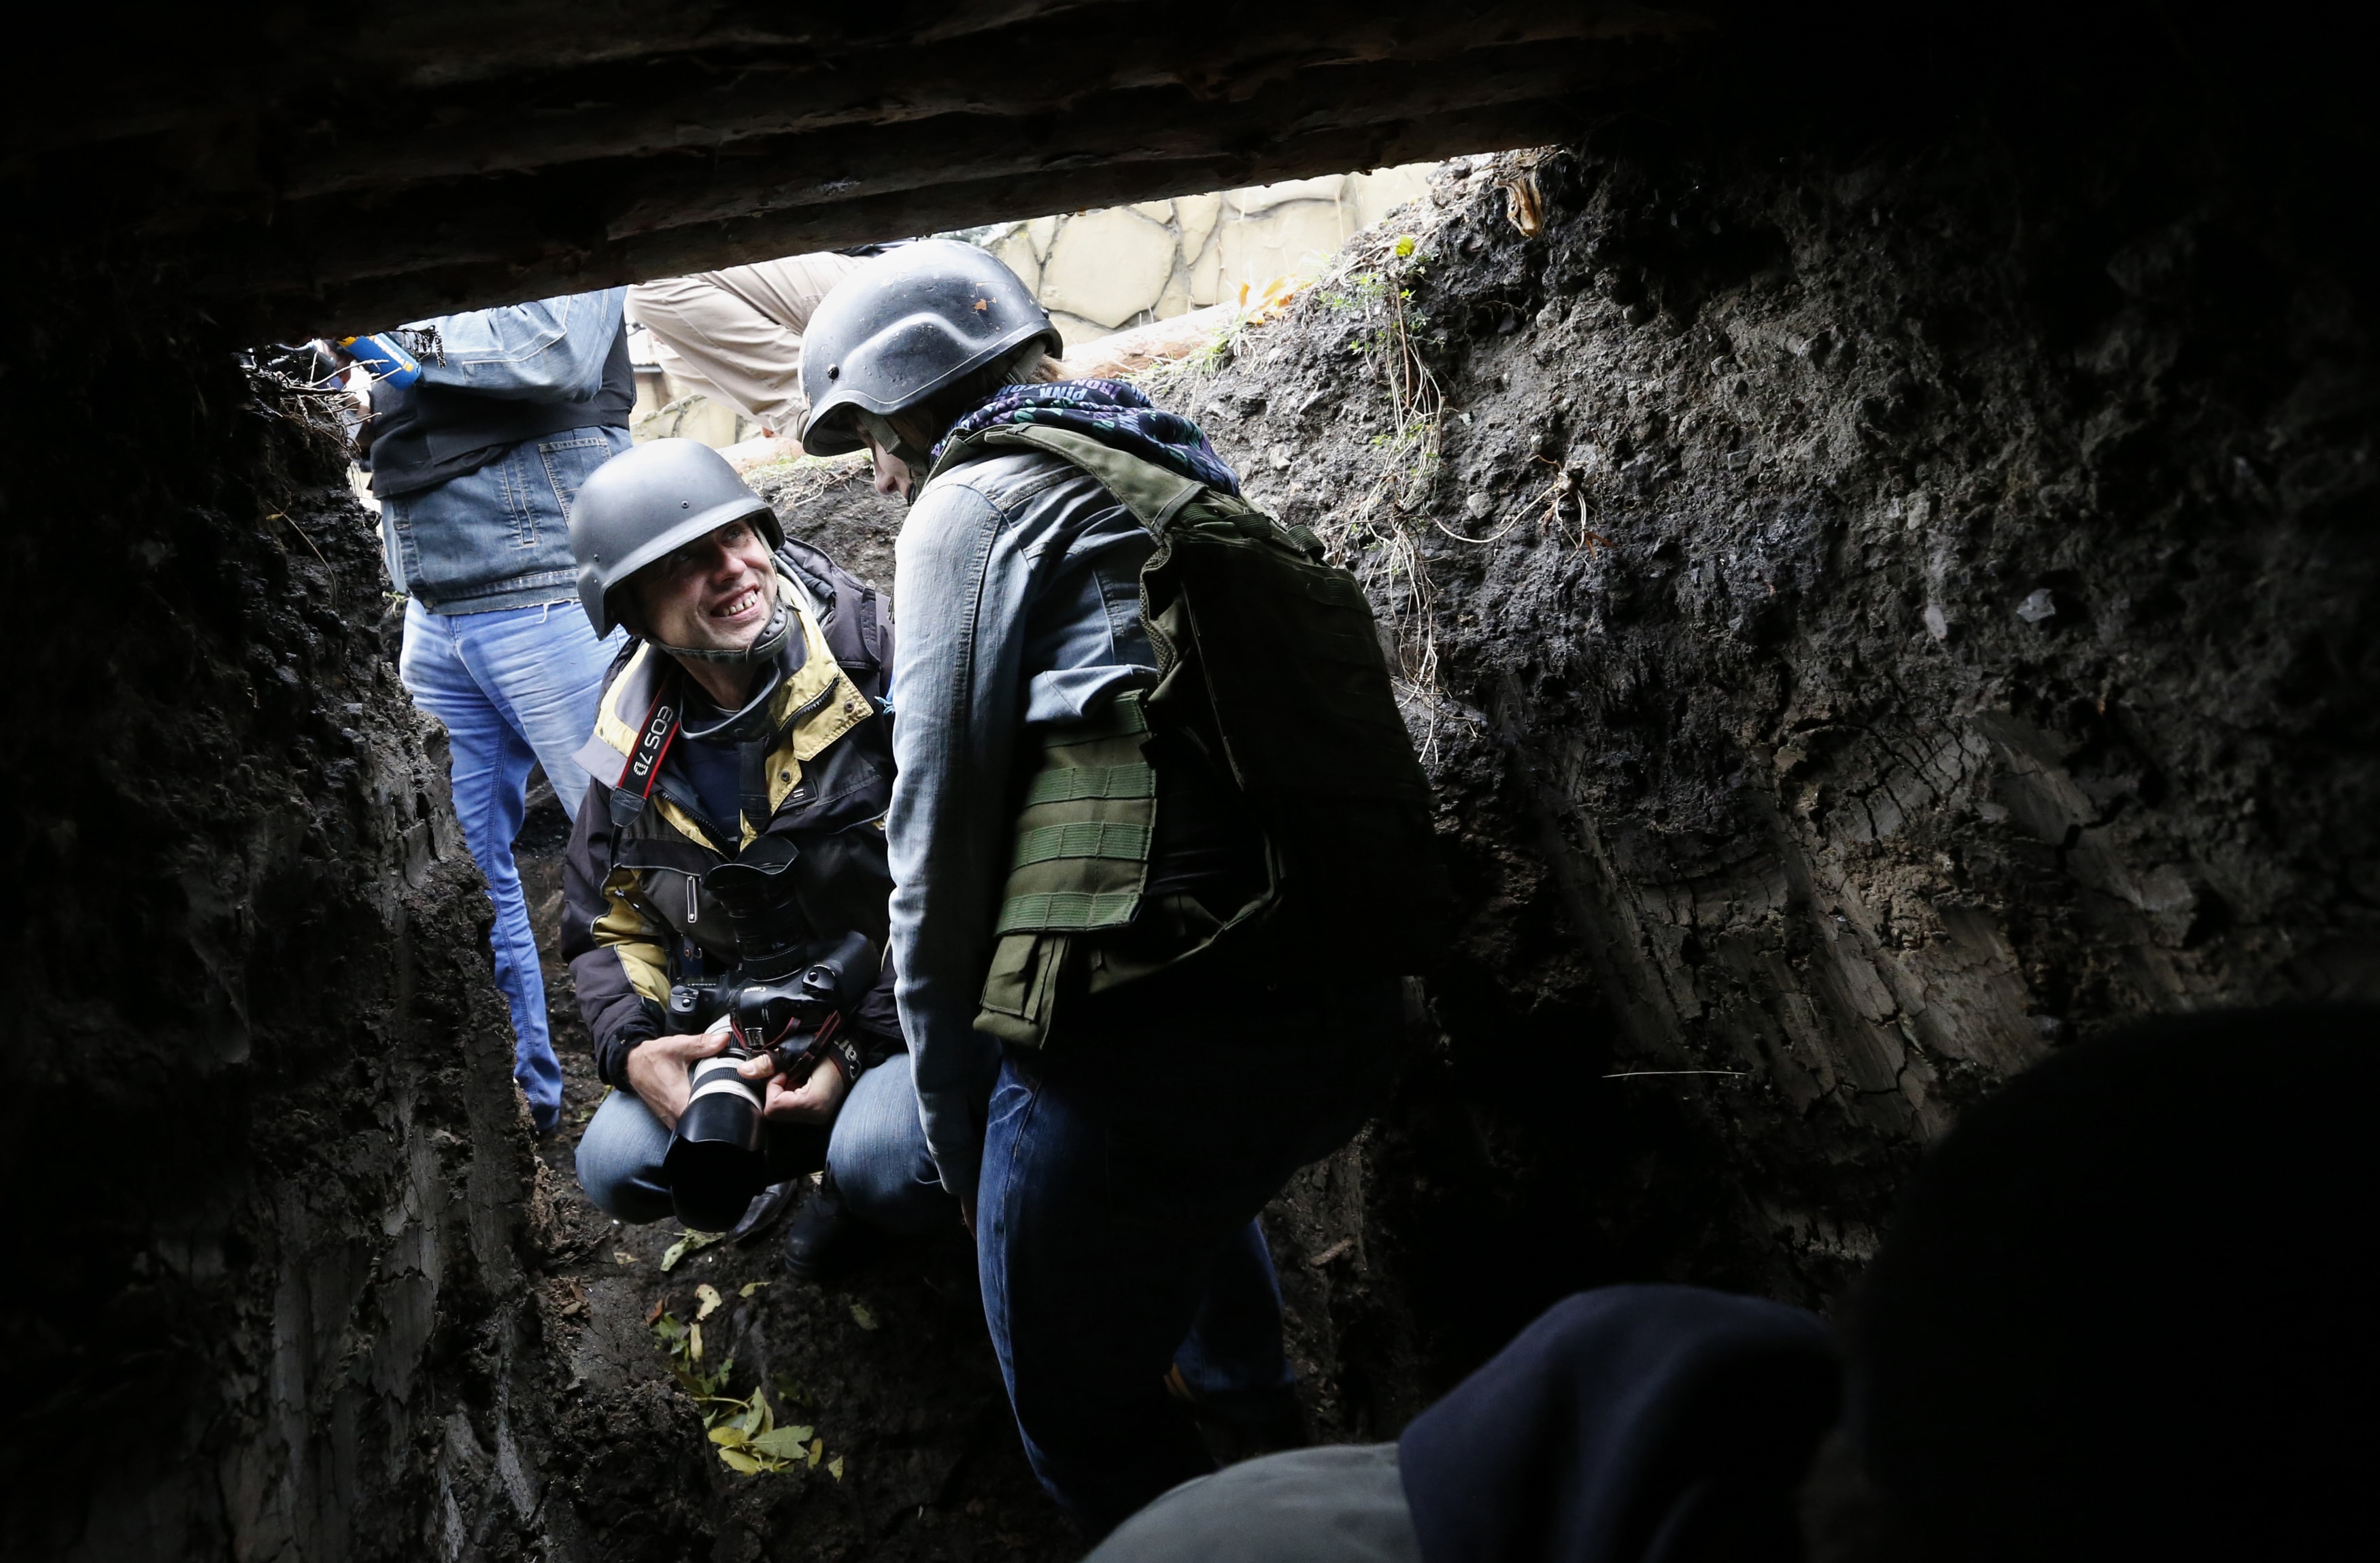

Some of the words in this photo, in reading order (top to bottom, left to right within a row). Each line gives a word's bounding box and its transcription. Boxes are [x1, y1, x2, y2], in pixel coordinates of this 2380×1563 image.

[1039, 386, 1088, 401] PINK
[1071, 379, 1121, 400] IRON
[644, 706, 673, 750] EOS
[633, 752, 653, 776] 7D
